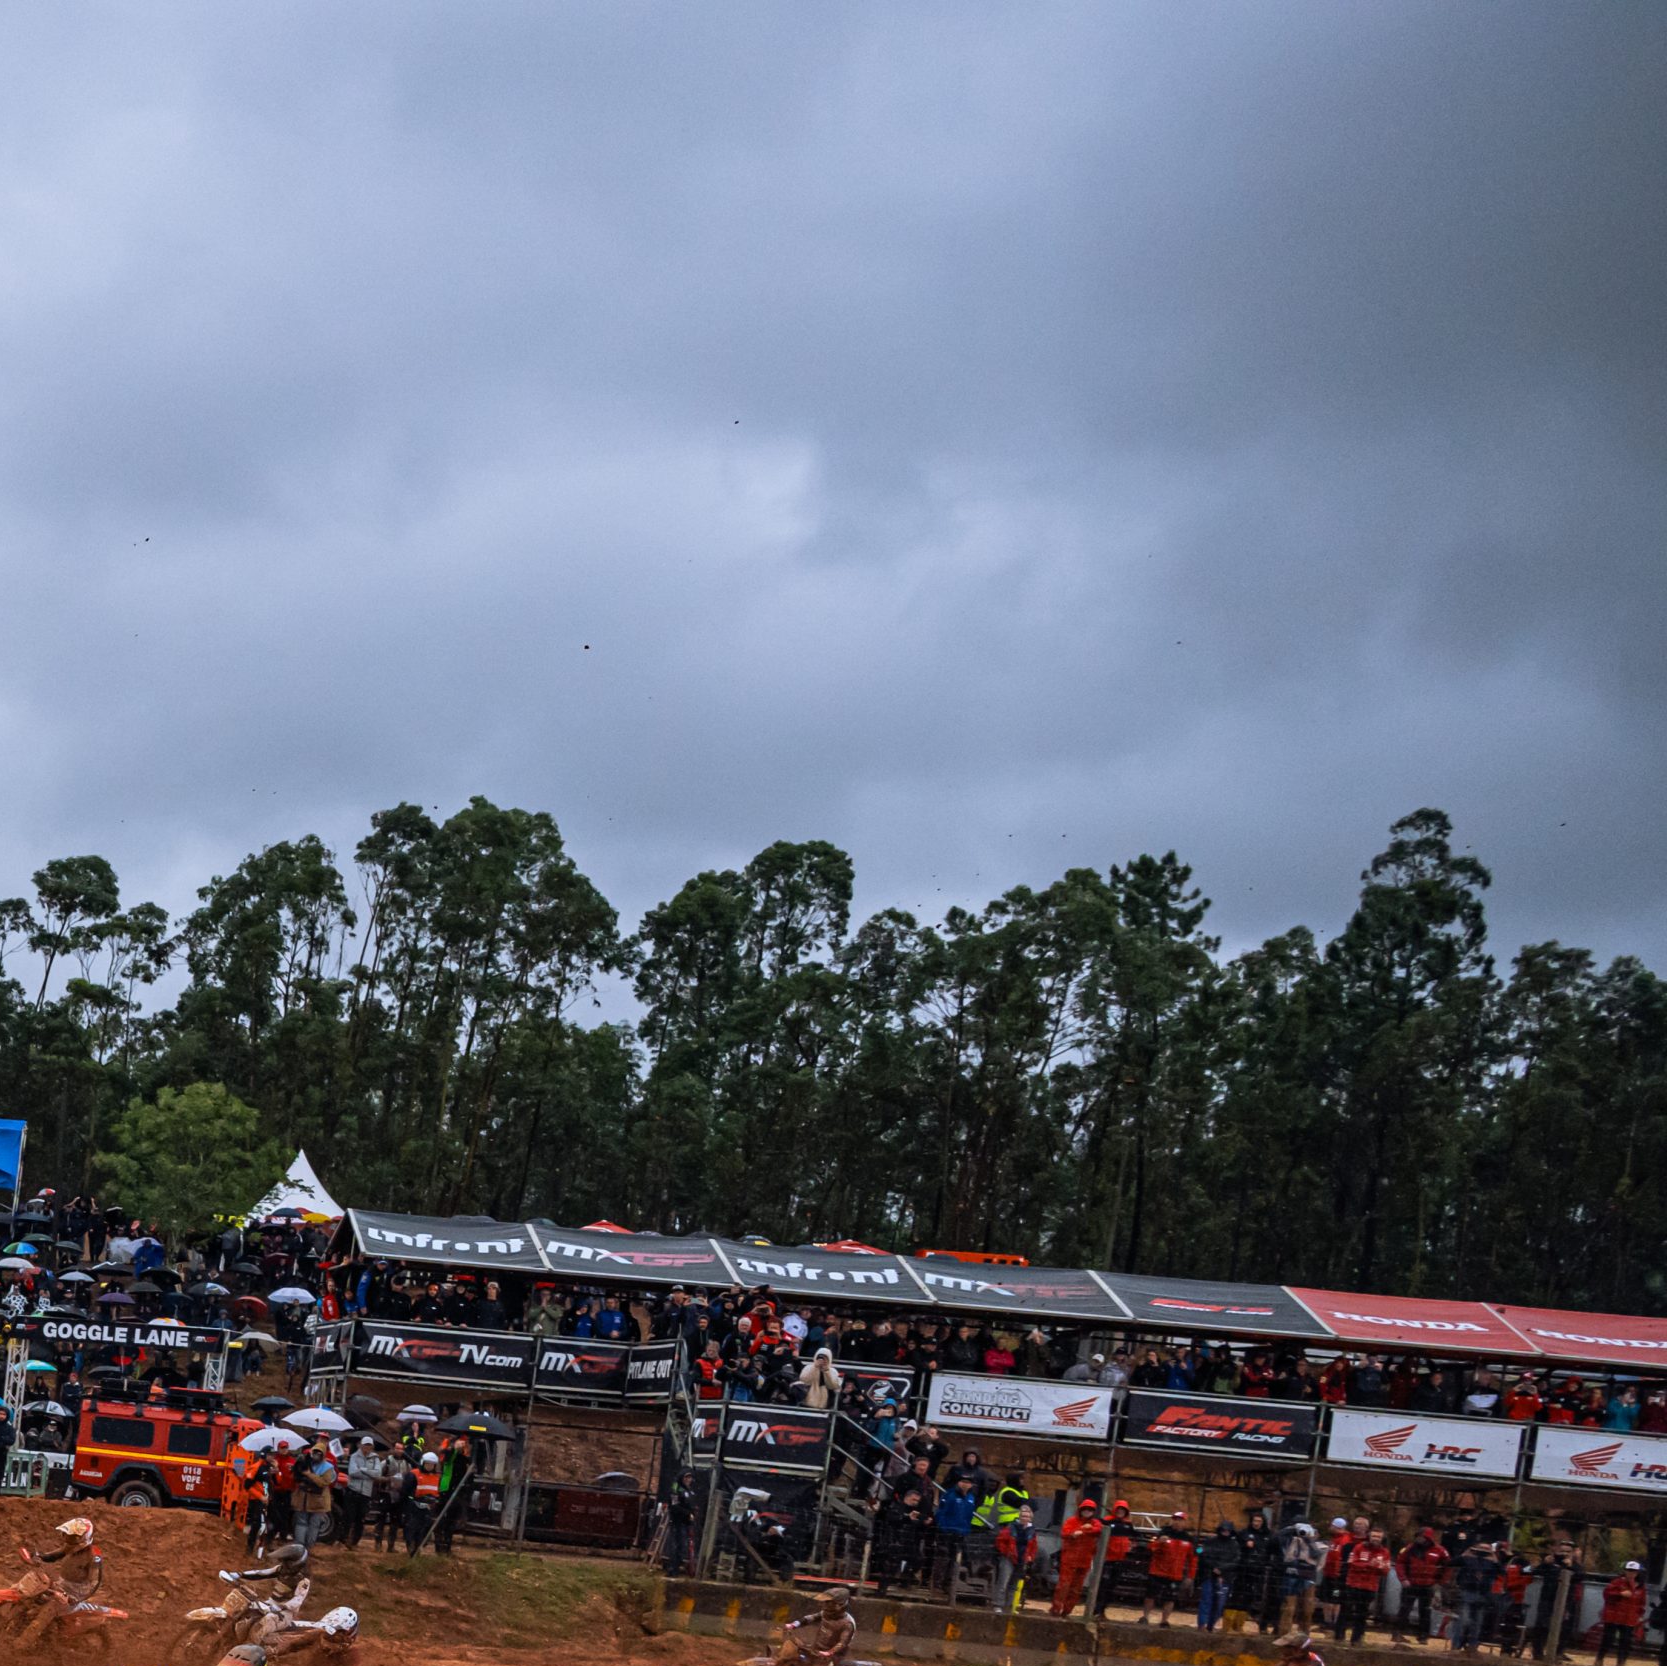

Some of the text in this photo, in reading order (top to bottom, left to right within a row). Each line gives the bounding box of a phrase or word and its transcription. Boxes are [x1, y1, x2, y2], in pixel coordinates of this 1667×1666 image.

[43, 1321, 128, 1343] GOGGLE
[133, 1327, 190, 1348] LANE
[940, 1401, 1031, 1422] CONSTRUCT
[1154, 1404, 1295, 1437] FANTIC
[1051, 1420, 1096, 1431] HONDA
[1152, 1424, 1286, 1445] FACTORY RACING
[1362, 1450, 1415, 1463] HONDA
[1423, 1443, 1484, 1463] HRC
[1568, 1468, 1620, 1481] HONDA
